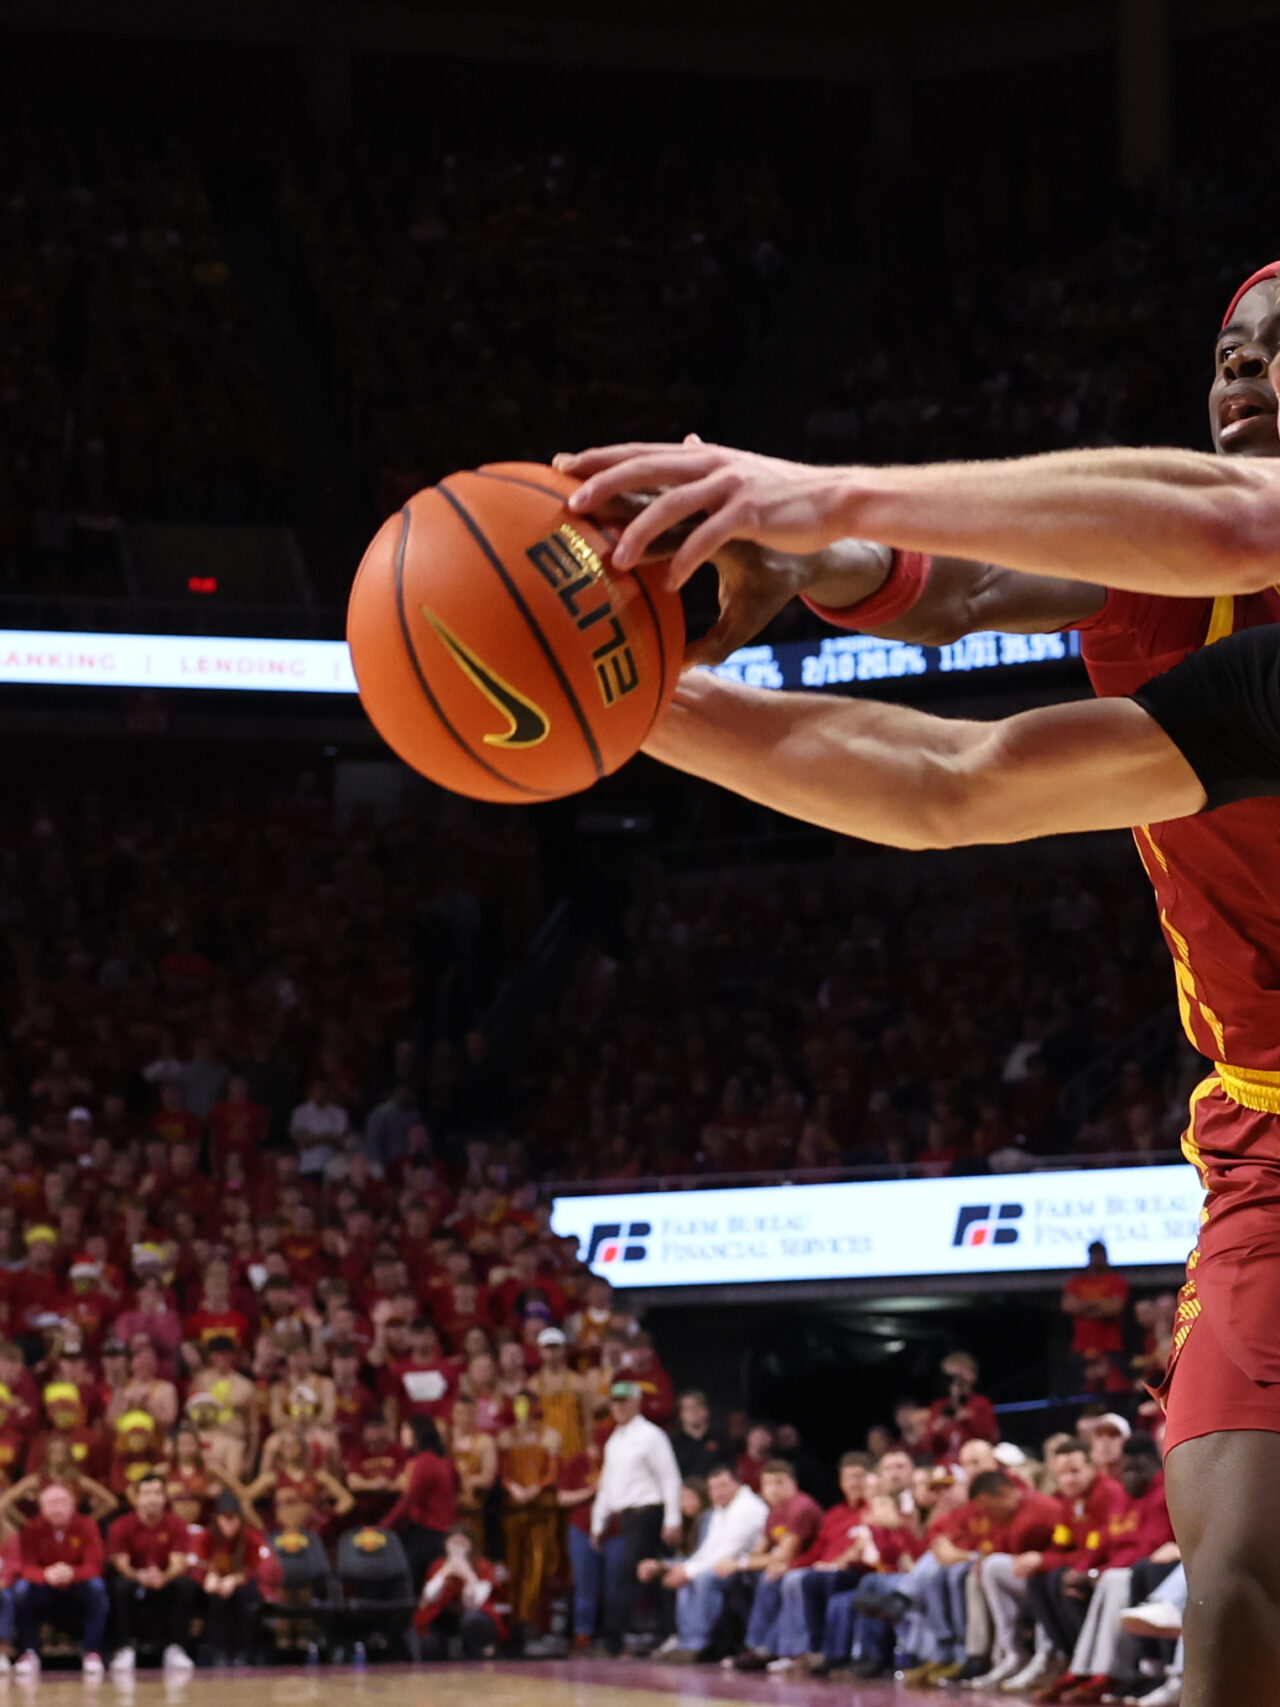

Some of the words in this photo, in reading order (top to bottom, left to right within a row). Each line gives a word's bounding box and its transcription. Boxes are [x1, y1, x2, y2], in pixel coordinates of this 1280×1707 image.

[0, 651, 117, 672] ANKING
[180, 653, 307, 677] LENDING
[525, 532, 639, 708] ELITE
